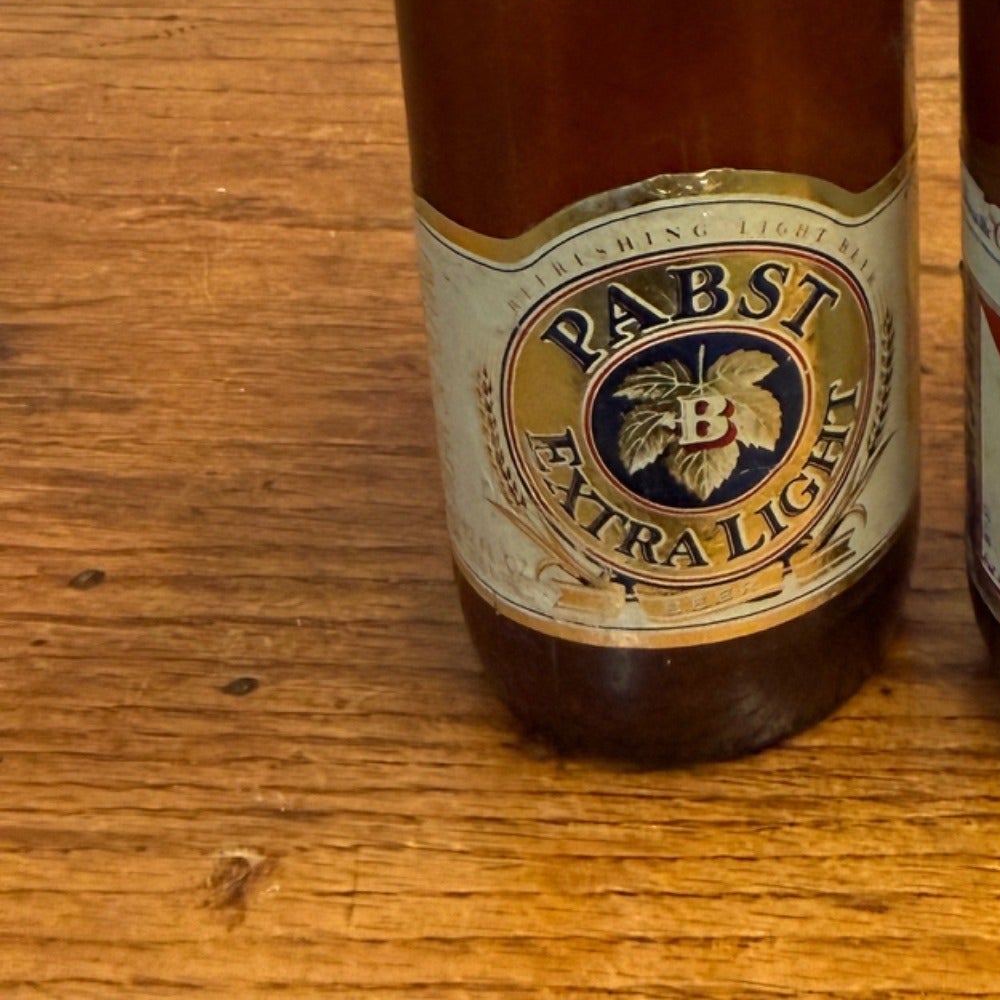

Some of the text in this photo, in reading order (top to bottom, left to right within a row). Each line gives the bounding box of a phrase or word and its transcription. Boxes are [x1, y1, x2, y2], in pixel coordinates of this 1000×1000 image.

[541, 262, 841, 373] PABST
[526, 379, 863, 567] EXTRA LIGHT
[677, 395, 732, 447] B
